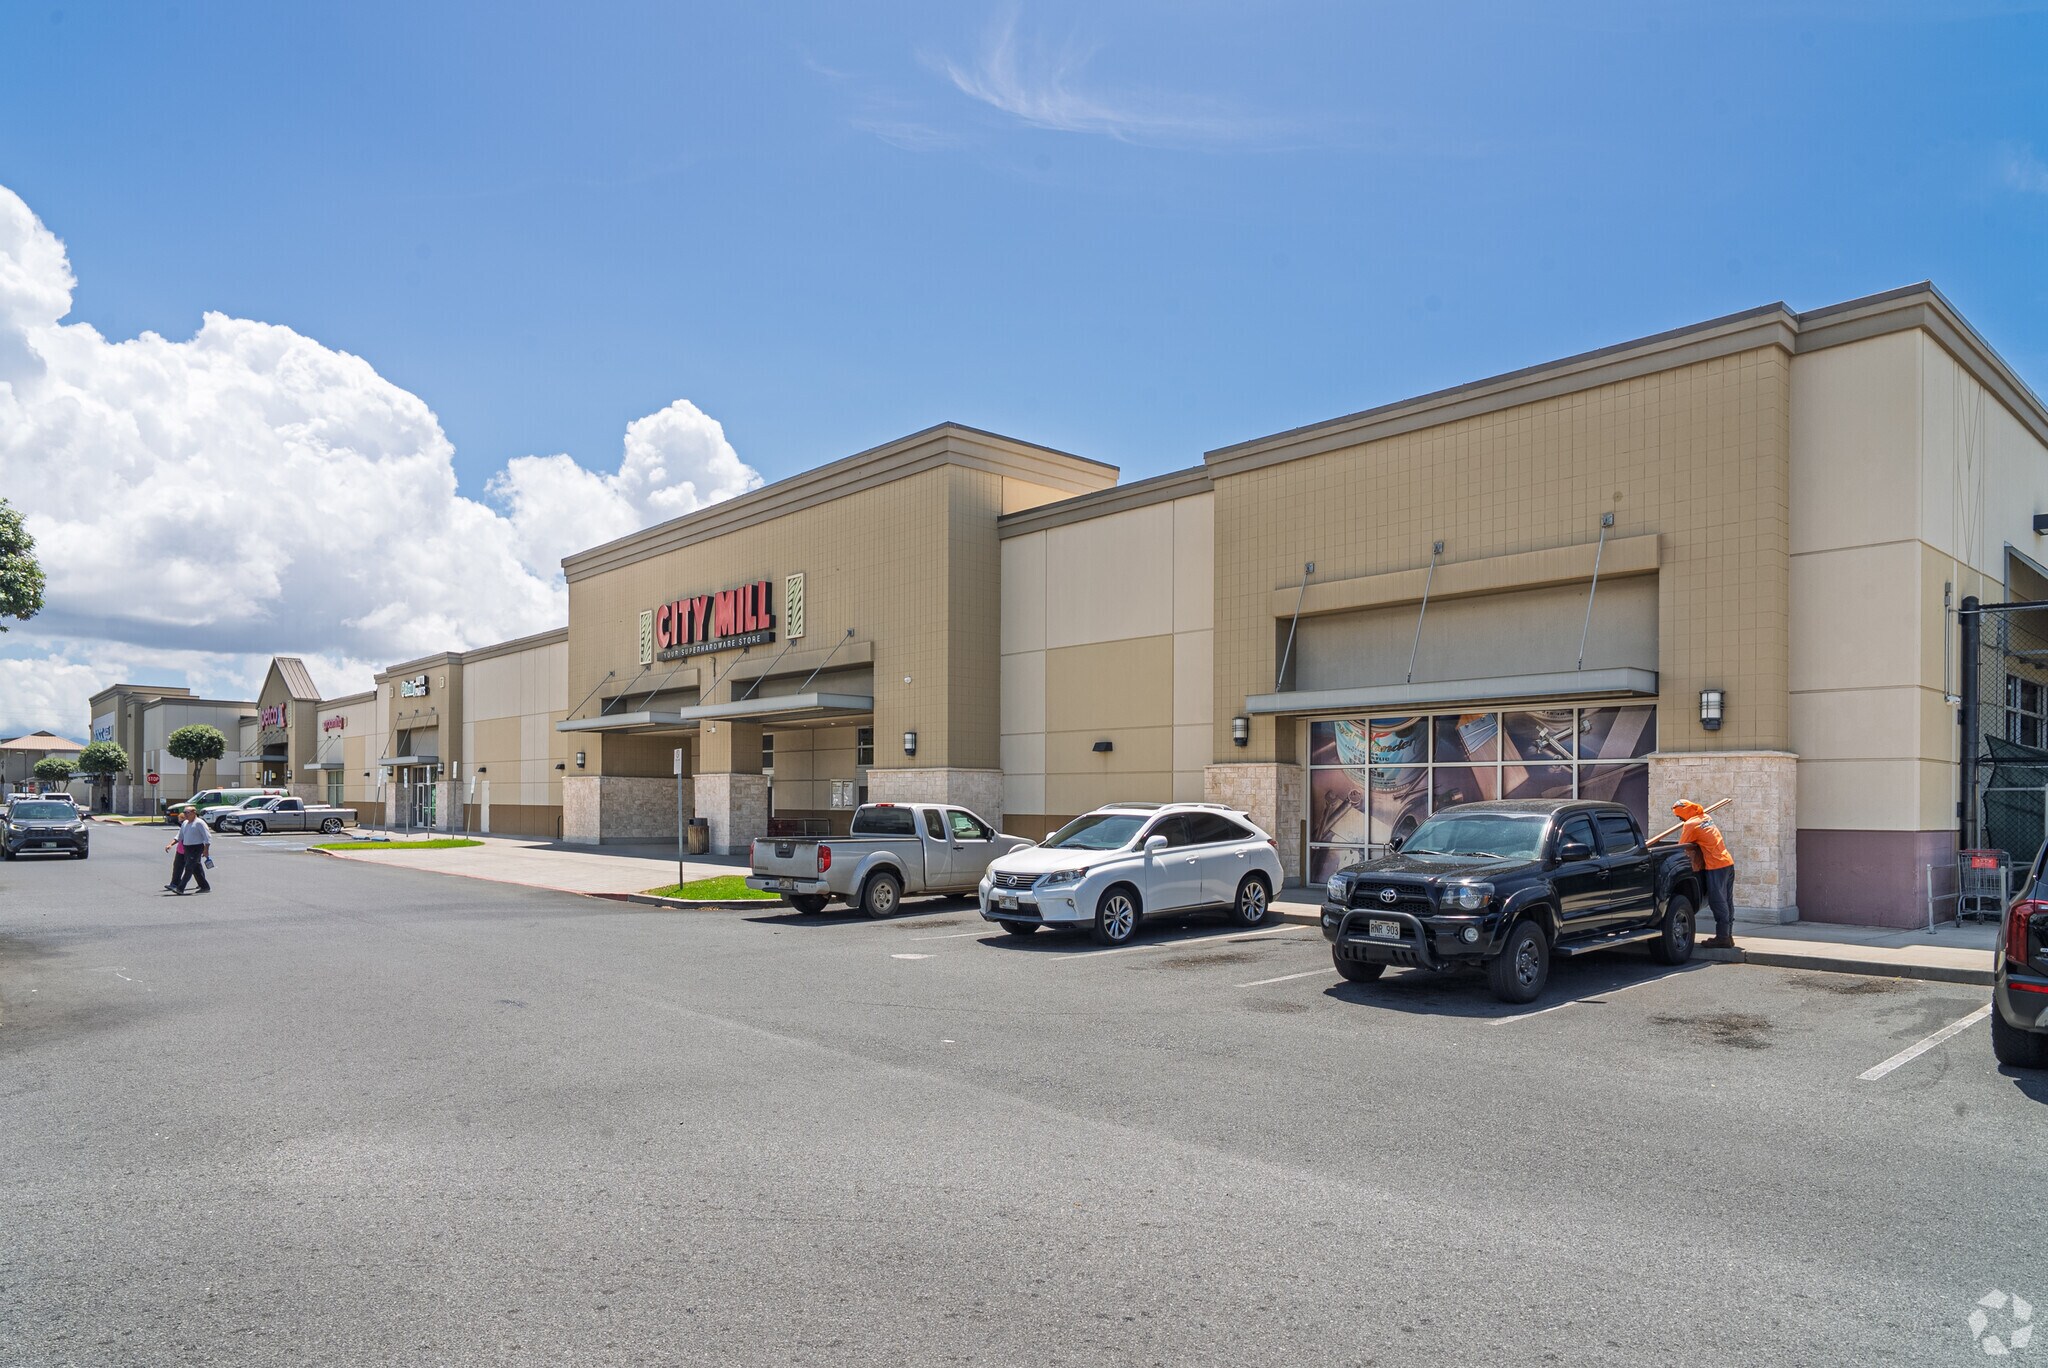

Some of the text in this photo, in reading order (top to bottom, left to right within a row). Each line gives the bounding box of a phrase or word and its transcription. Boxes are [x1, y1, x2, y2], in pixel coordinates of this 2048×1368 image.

[656, 581, 771, 649] CITY MILL
[663, 634, 761, 659] YOUR SUPERHARDWARE STORE
[1386, 925, 1398, 935] 903
